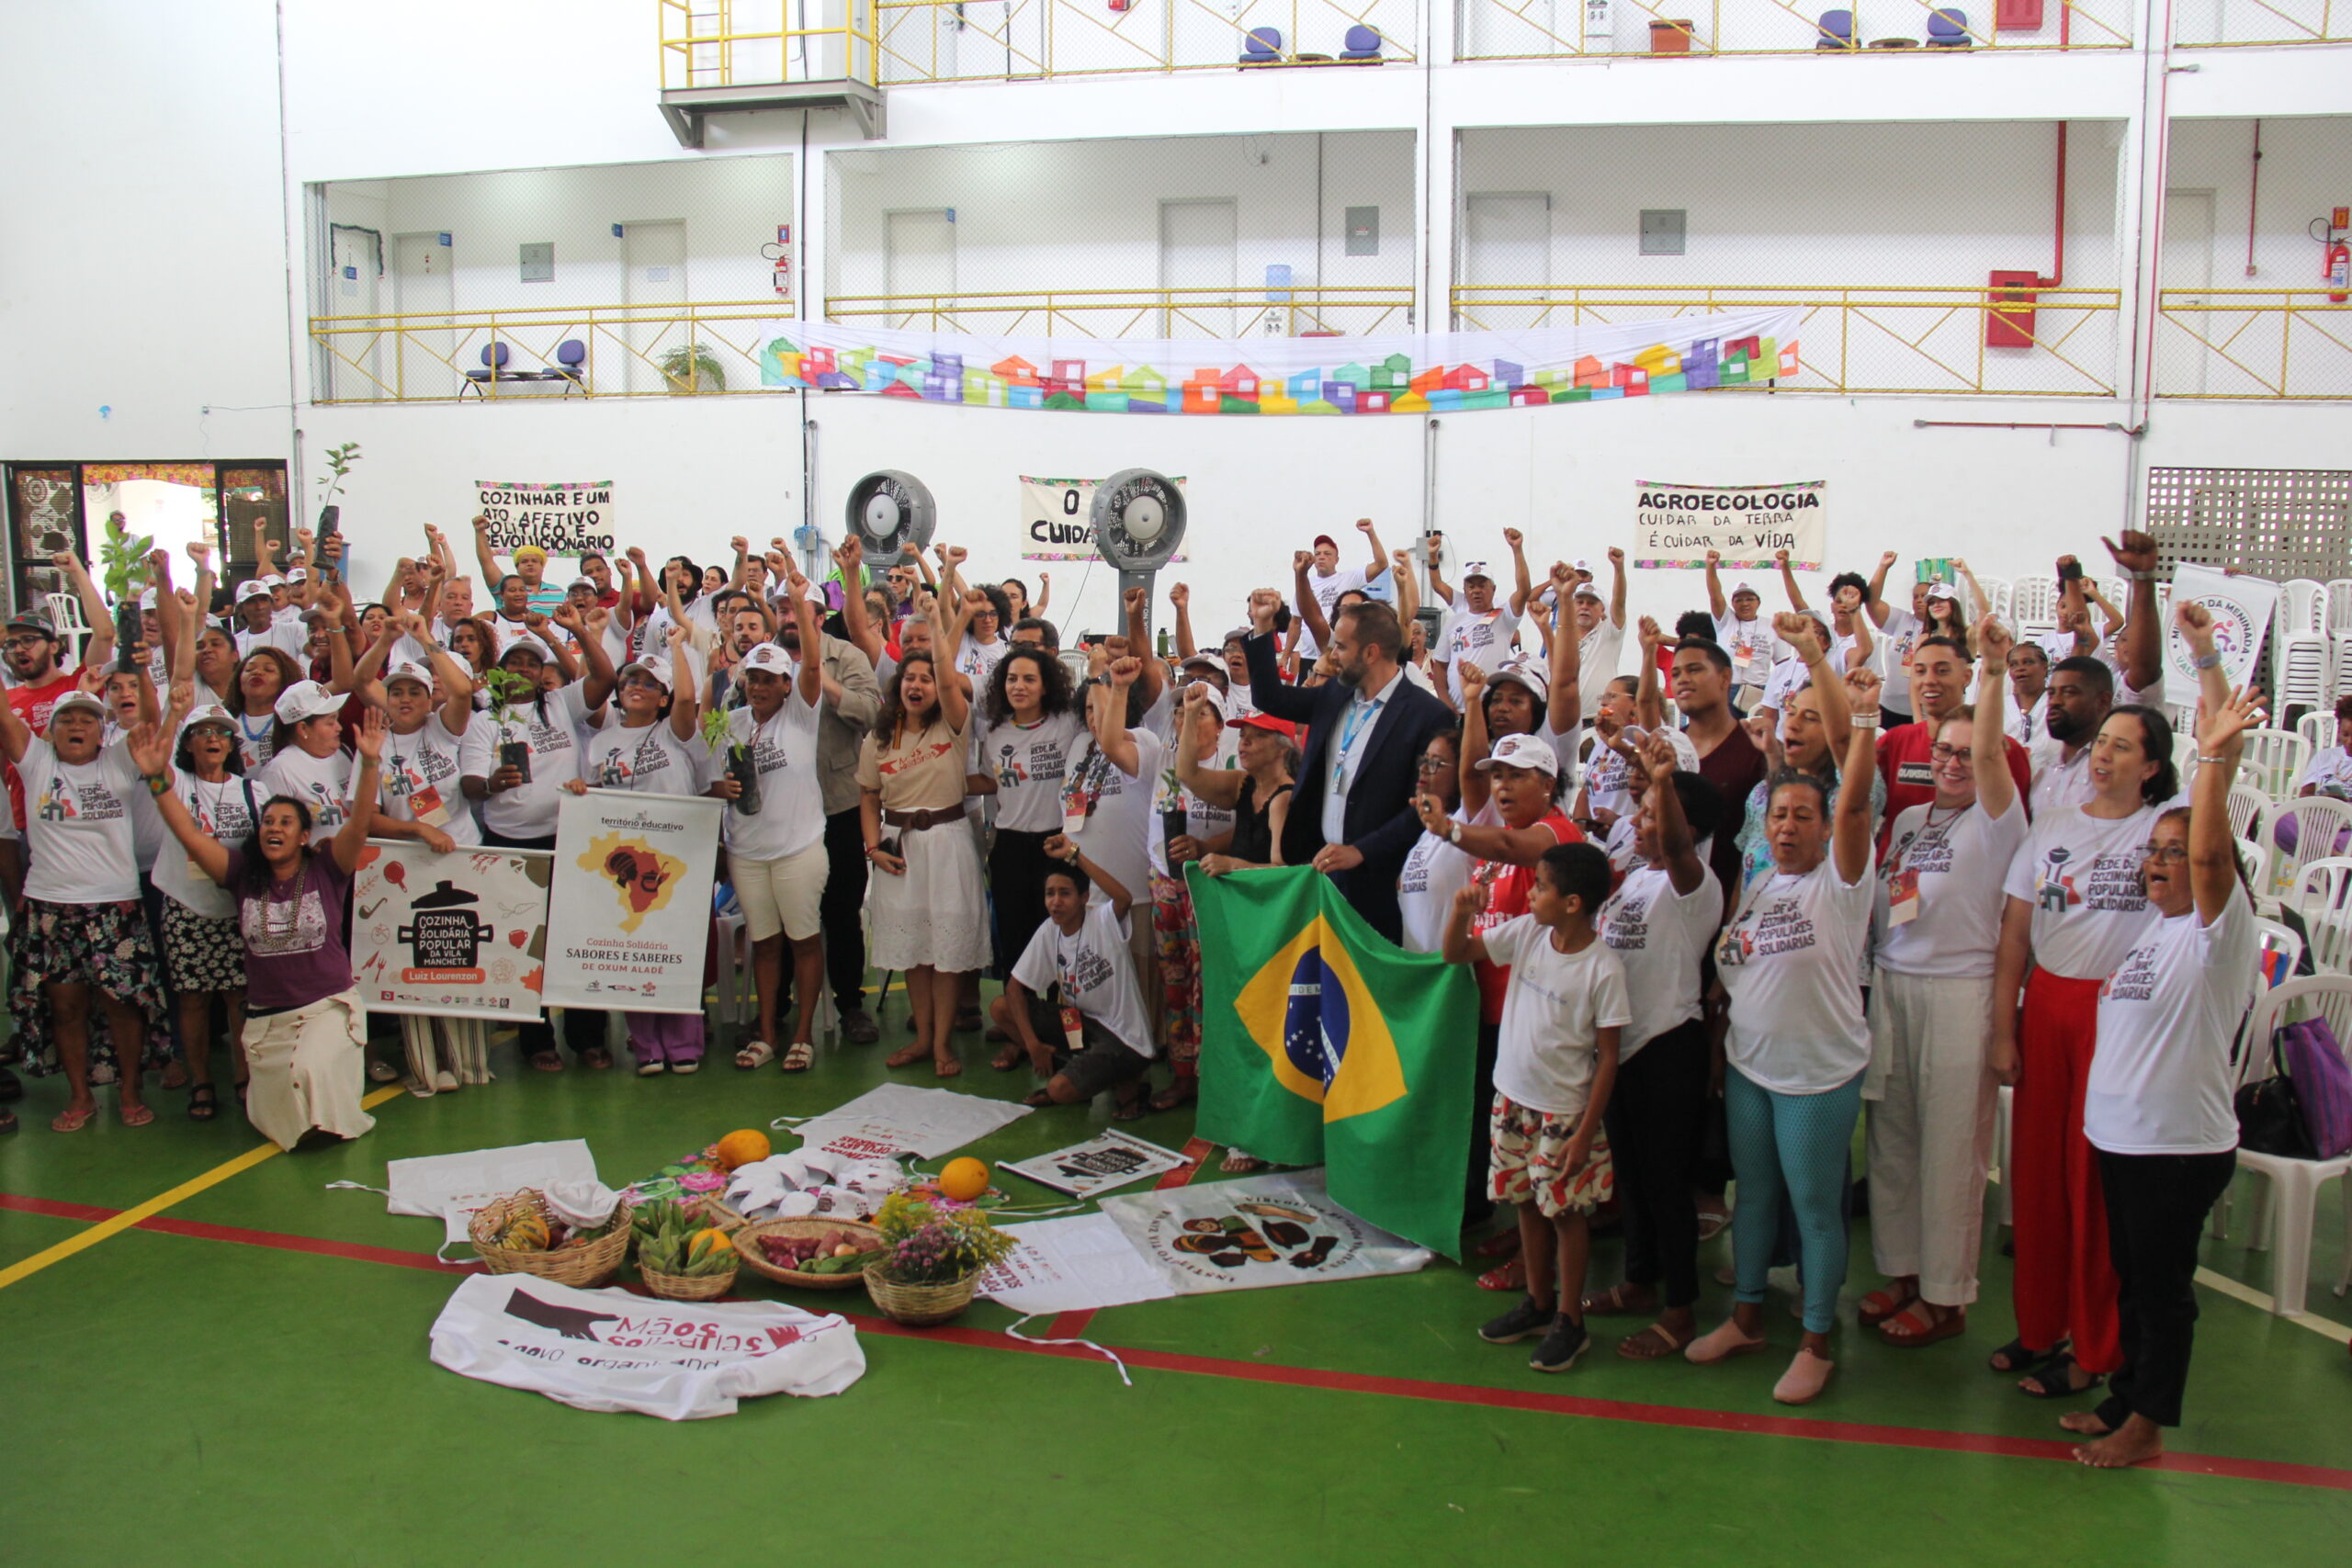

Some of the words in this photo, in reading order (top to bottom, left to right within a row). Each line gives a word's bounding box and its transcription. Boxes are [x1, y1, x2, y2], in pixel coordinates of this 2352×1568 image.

[481, 491, 567, 506] COZINHAR
[586, 491, 610, 504] UM
[1063, 489, 1080, 515] O
[1637, 492, 1820, 511] AGROECOLOGIA
[519, 510, 600, 527] AFETIVO
[1638, 513, 1697, 526] CUIDAR
[1713, 515, 1732, 526] DA
[1745, 513, 1794, 525] TERRA
[575, 524, 585, 538] E
[1649, 530, 1658, 548] É
[1728, 536, 1745, 547] DA
[2208, 598, 2223, 608] DA
[2224, 604, 2253, 654] MENINADA
[1030, 746, 1048, 755] REDE
[1049, 743, 1057, 751] DE
[1031, 751, 1062, 763] COZINHAS
[601, 817, 639, 827] território
[641, 818, 684, 831] educativo
[2093, 859, 2120, 870] REDE
[419, 916, 474, 930] COZINHA
[419, 927, 470, 939] SOLIDÁRIA
[1758, 920, 1813, 941] POPULARES
[419, 940, 471, 951] POPULAR
[586, 938, 625, 948] Cozinha
[566, 948, 620, 961] SABORES
[622, 952, 629, 962] E
[633, 953, 683, 964] SABERES
[582, 963, 595, 971] DE
[598, 964, 628, 973] OXUM
[409, 971, 429, 980] Luiz
[431, 971, 478, 981] Lourenzon
[616, 1317, 719, 1337] Mãos
